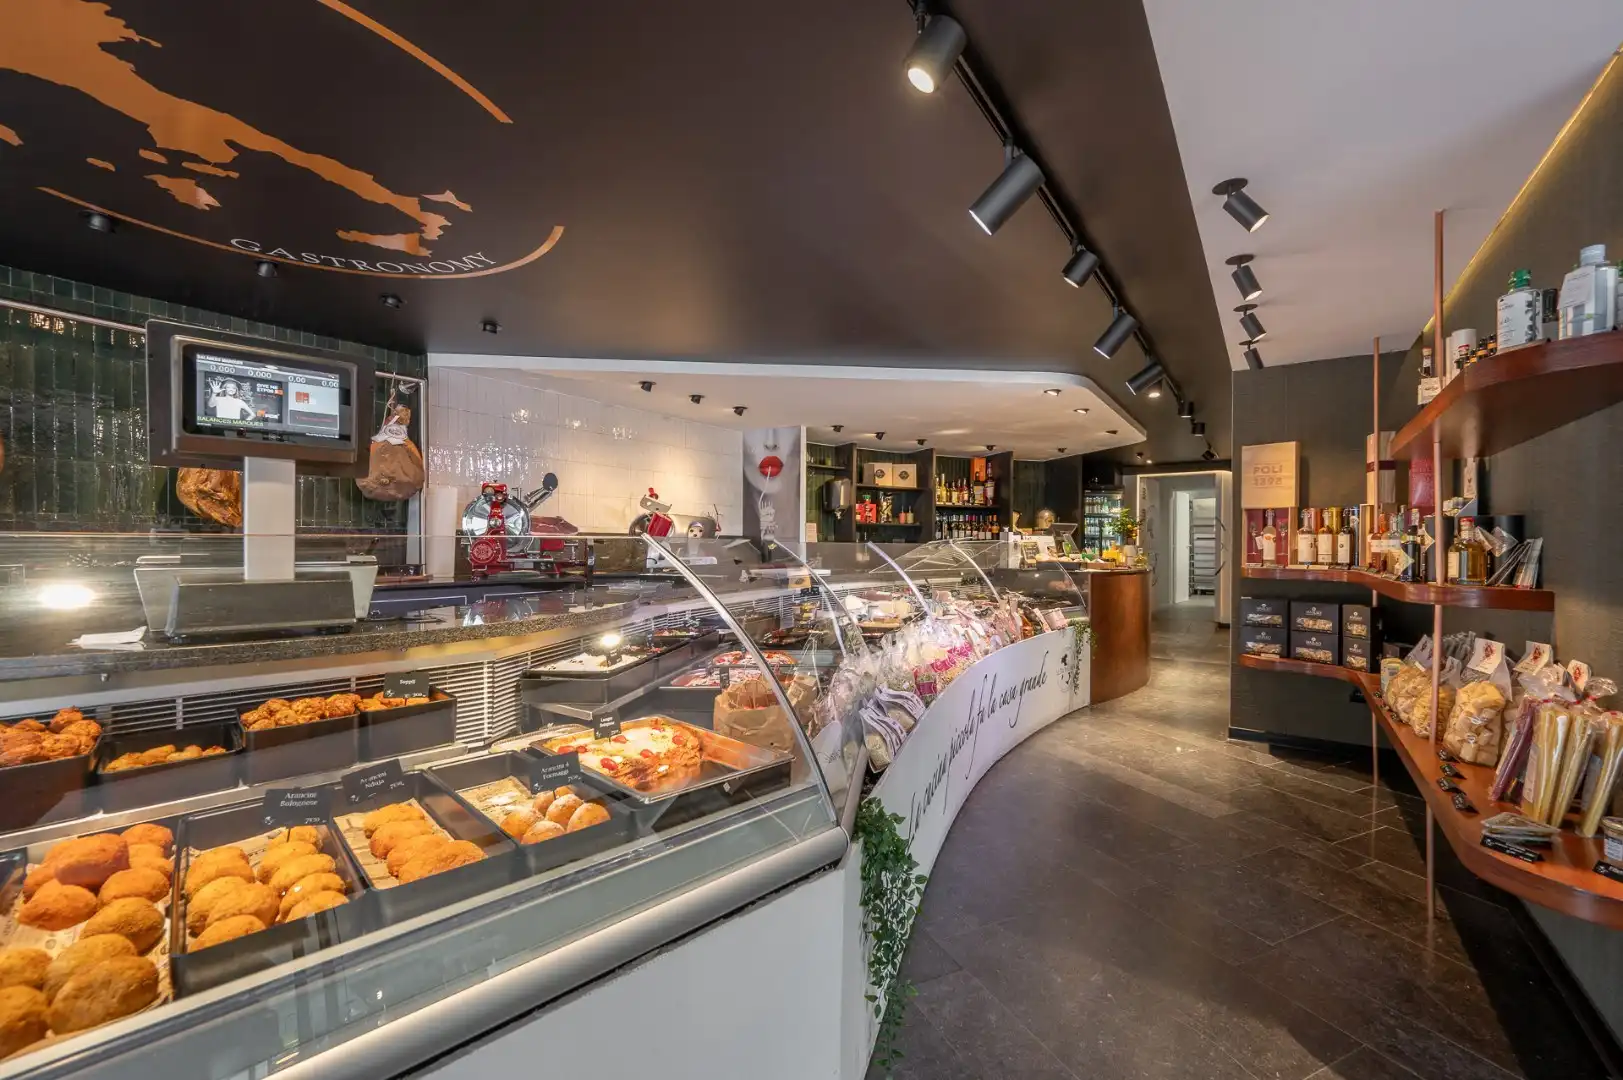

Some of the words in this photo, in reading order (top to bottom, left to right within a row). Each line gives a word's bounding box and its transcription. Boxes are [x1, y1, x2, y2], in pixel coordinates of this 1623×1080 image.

[230, 238, 497, 274] GASTRONOMY
[197, 416, 231, 424] BALANCES
[232, 419, 264, 427] MARQUES
[987, 673, 998, 719] la
[999, 688, 1018, 709] casa
[1008, 650, 1049, 729] grande
[965, 673, 988, 780] fa
